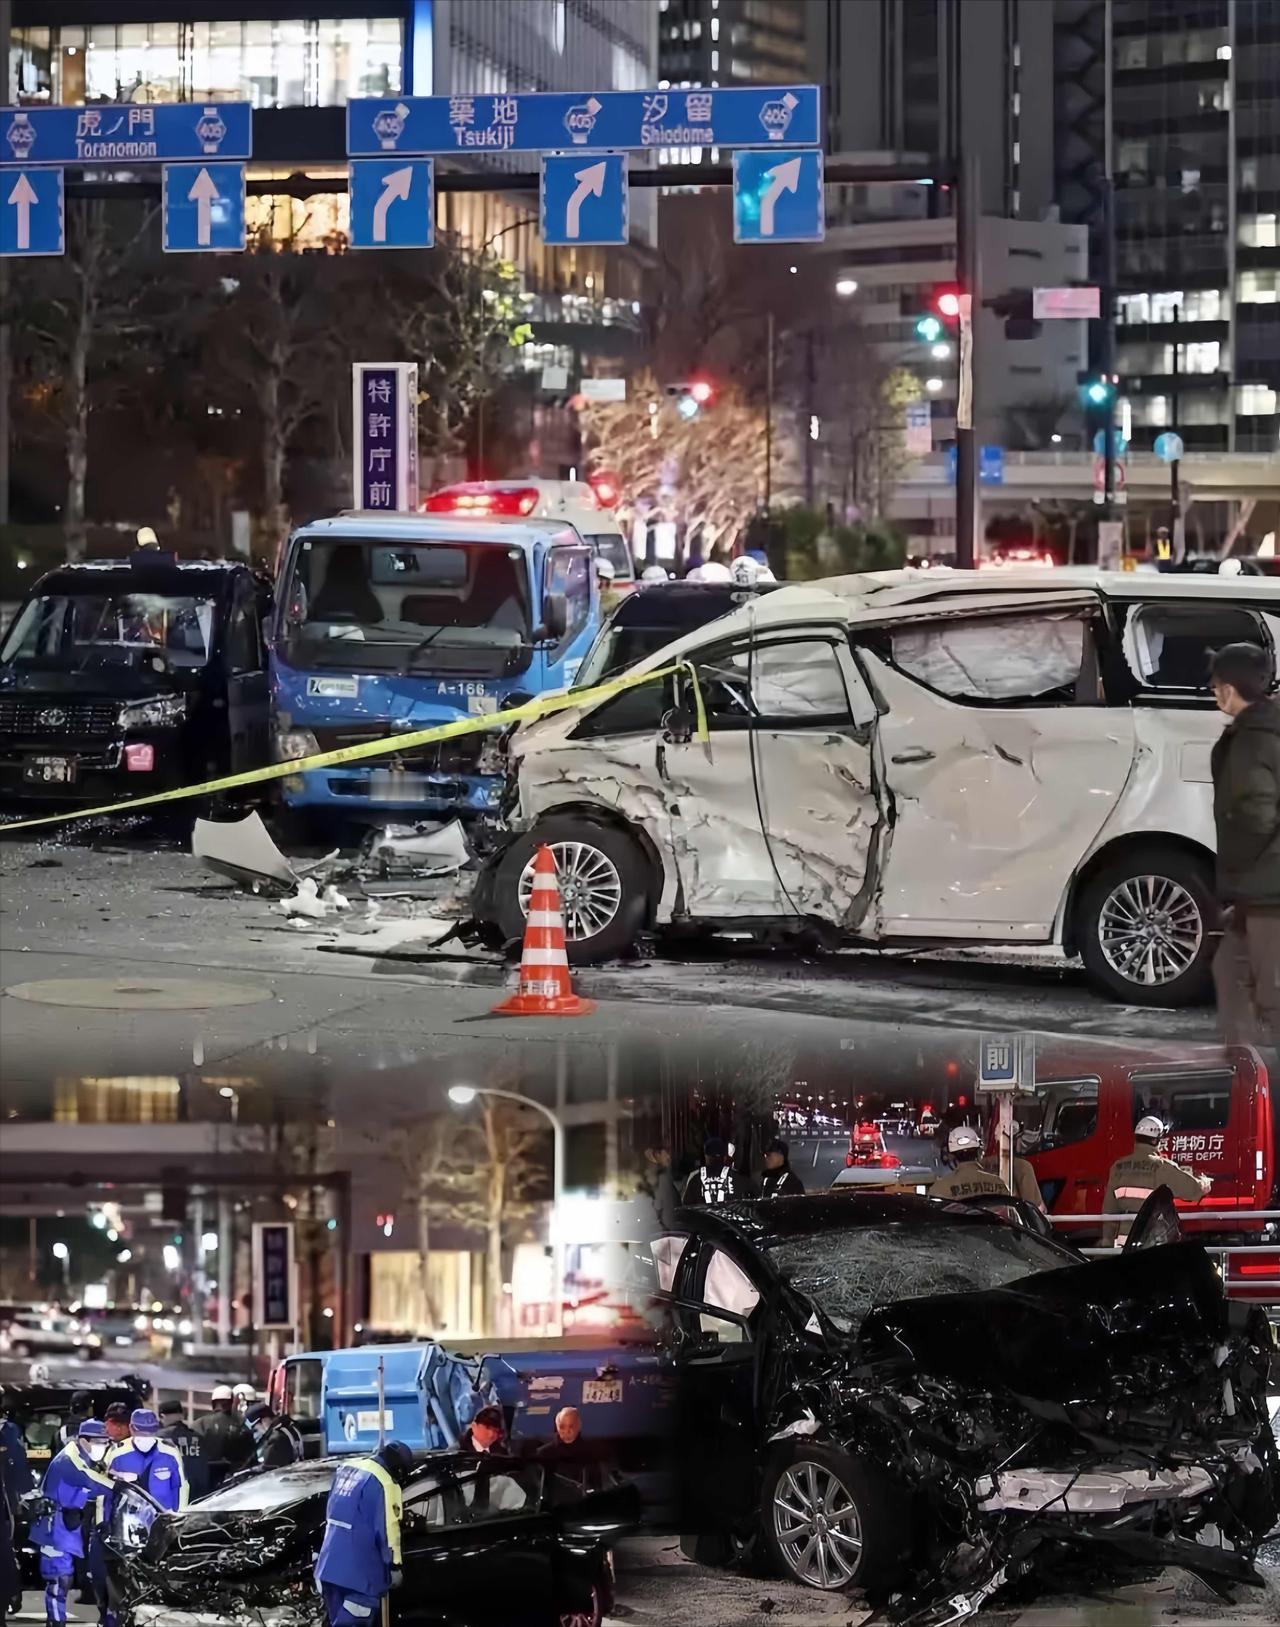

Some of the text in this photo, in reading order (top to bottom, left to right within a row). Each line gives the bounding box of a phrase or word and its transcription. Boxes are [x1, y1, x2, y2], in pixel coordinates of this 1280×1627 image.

[449, 97, 518, 126] 築地
[642, 93, 713, 122] 汐留
[76, 109, 155, 137] 虎ノ門
[641, 124, 714, 145] Shiodome
[75, 139, 157, 159] Toranomon
[454, 126, 515, 149] Tsukiji
[368, 379, 391, 506] 特許庁前
[986, 1034, 1009, 1071] 前
[1171, 1152, 1193, 1162] FIRE
[1195, 1151, 1224, 1161] DEPT.
